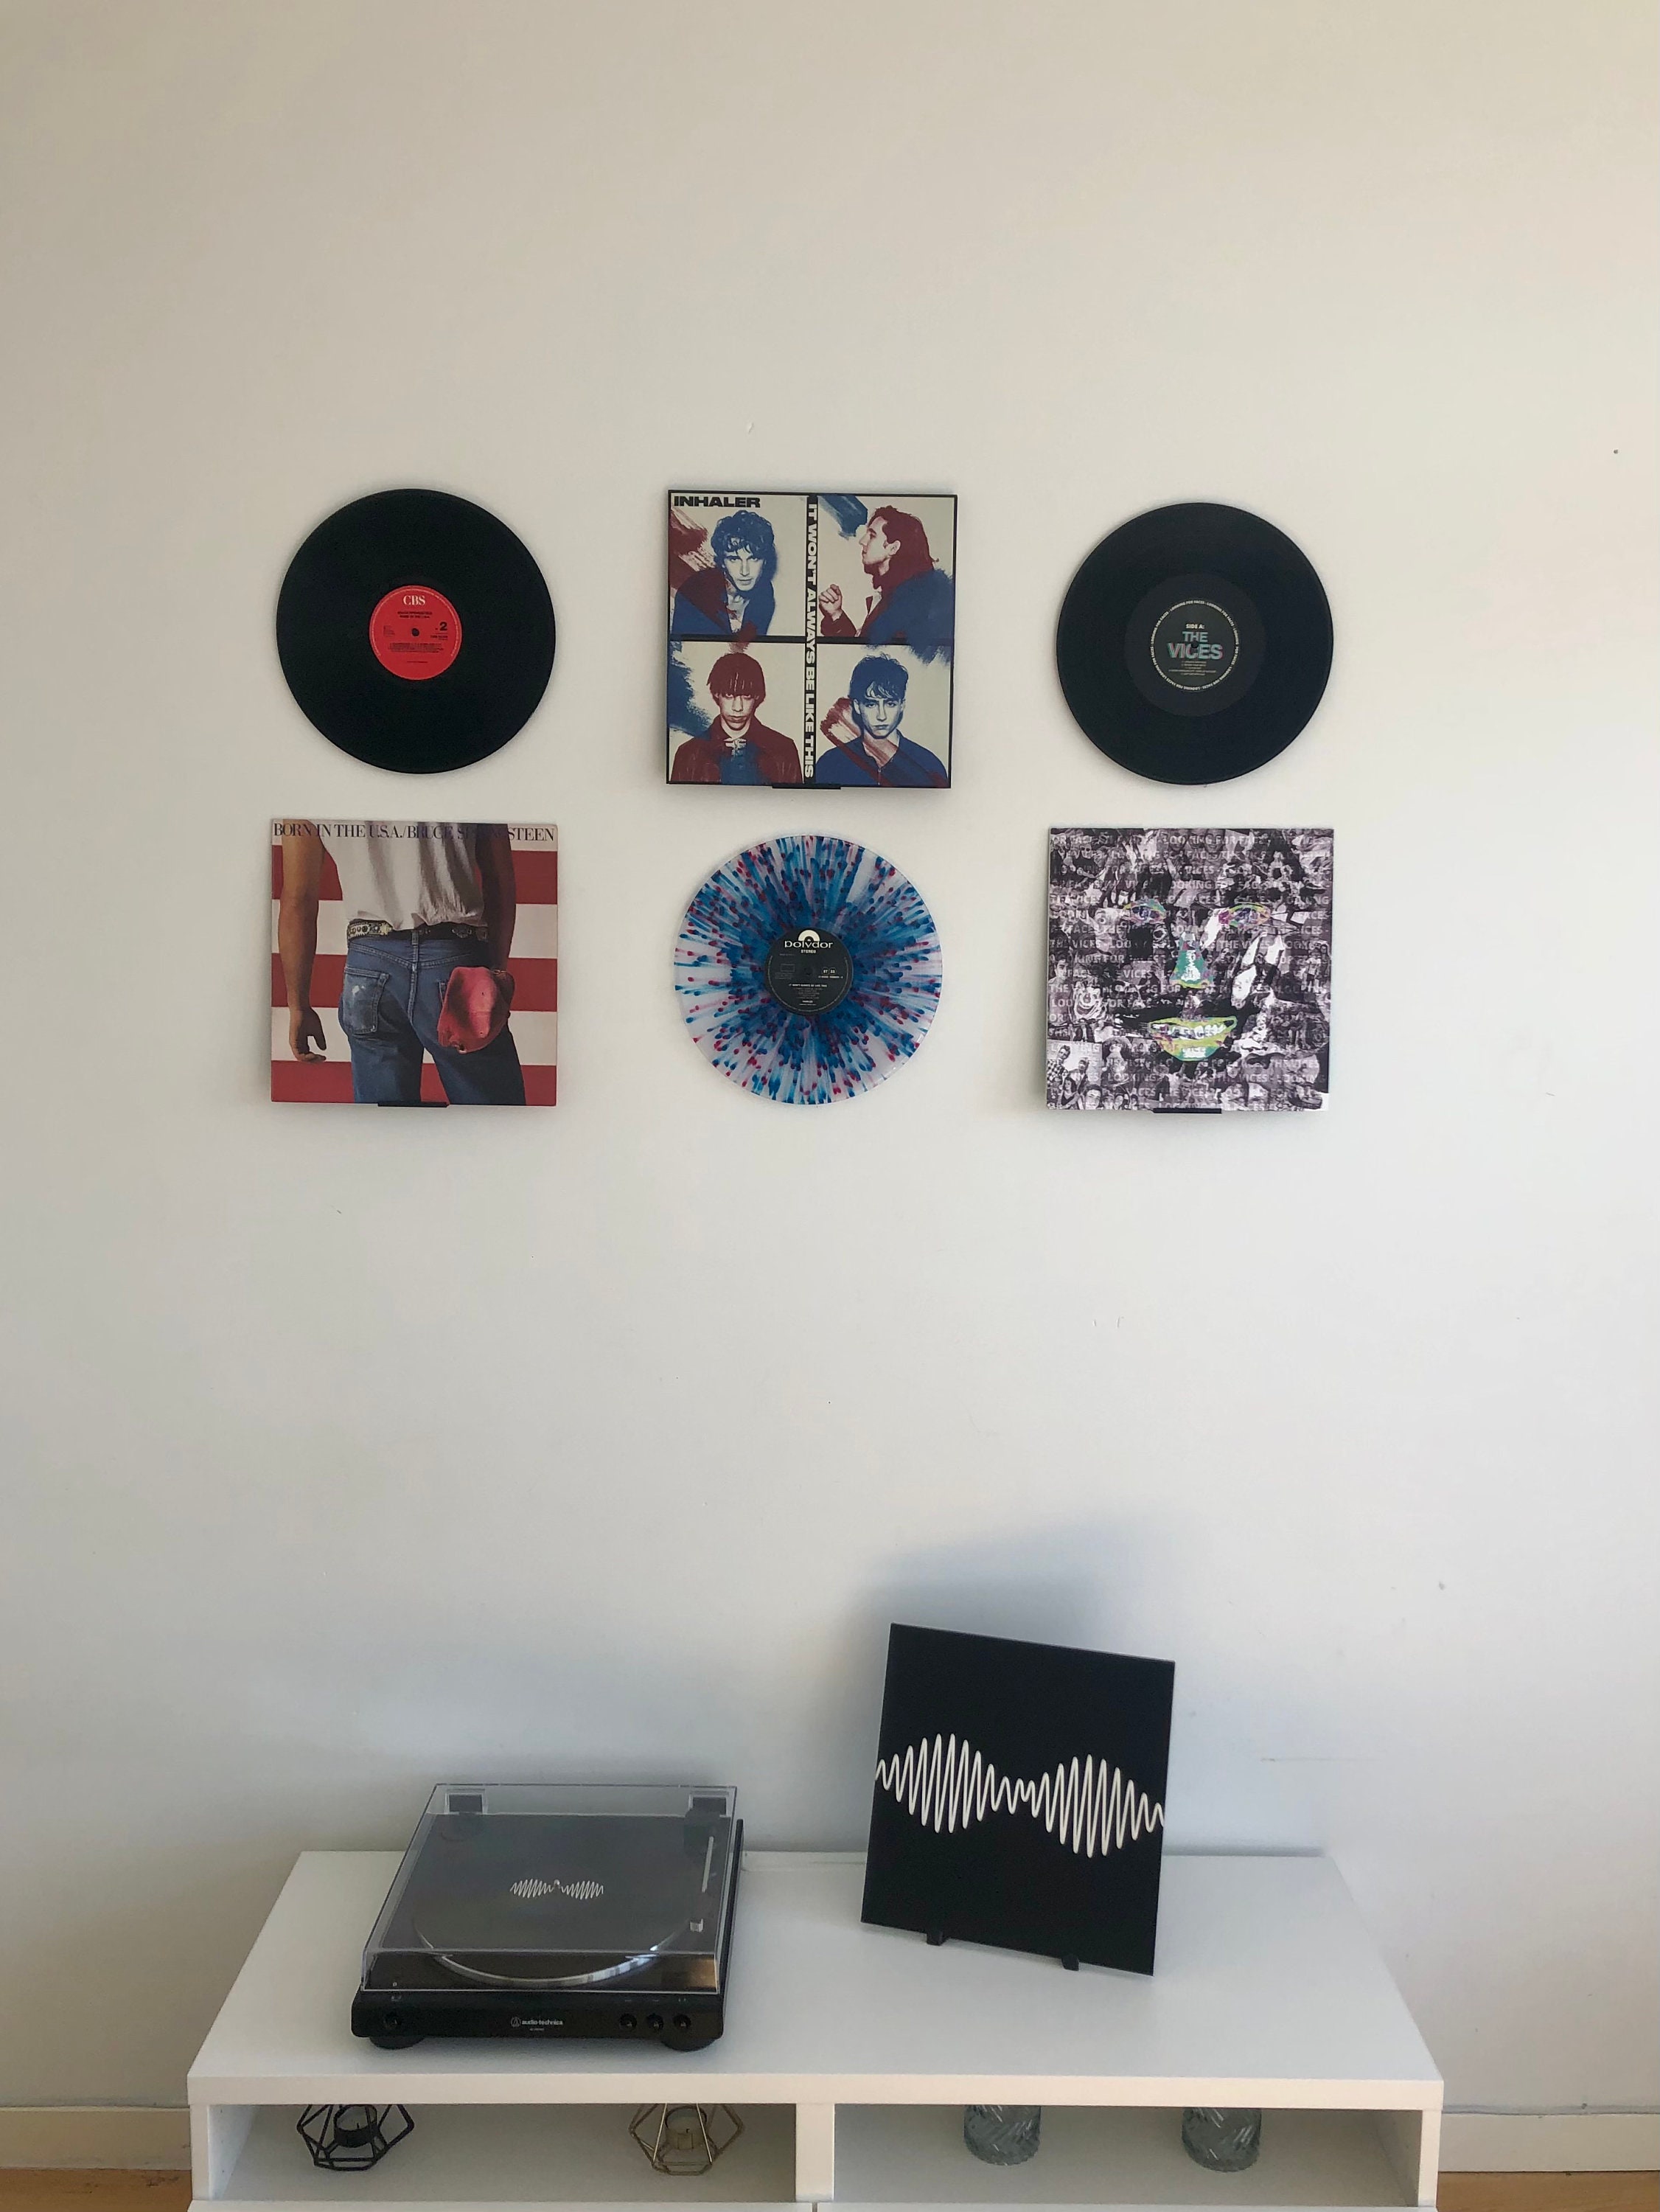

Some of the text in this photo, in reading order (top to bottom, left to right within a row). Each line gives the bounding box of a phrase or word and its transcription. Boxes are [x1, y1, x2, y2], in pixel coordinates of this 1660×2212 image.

[674, 495, 761, 508] INHALER
[403, 595, 426, 605] CBS
[439, 621, 448, 631] 2
[804, 504, 817, 778] IT WON'T ALWAYS BE LIKE THIS
[1182, 631, 1208, 642] THE
[1168, 642, 1224, 660] VICES
[273, 823, 312, 837] BORN
[315, 824, 332, 838] IN
[334, 824, 366, 838] THE
[784, 940, 833, 948] polydor
